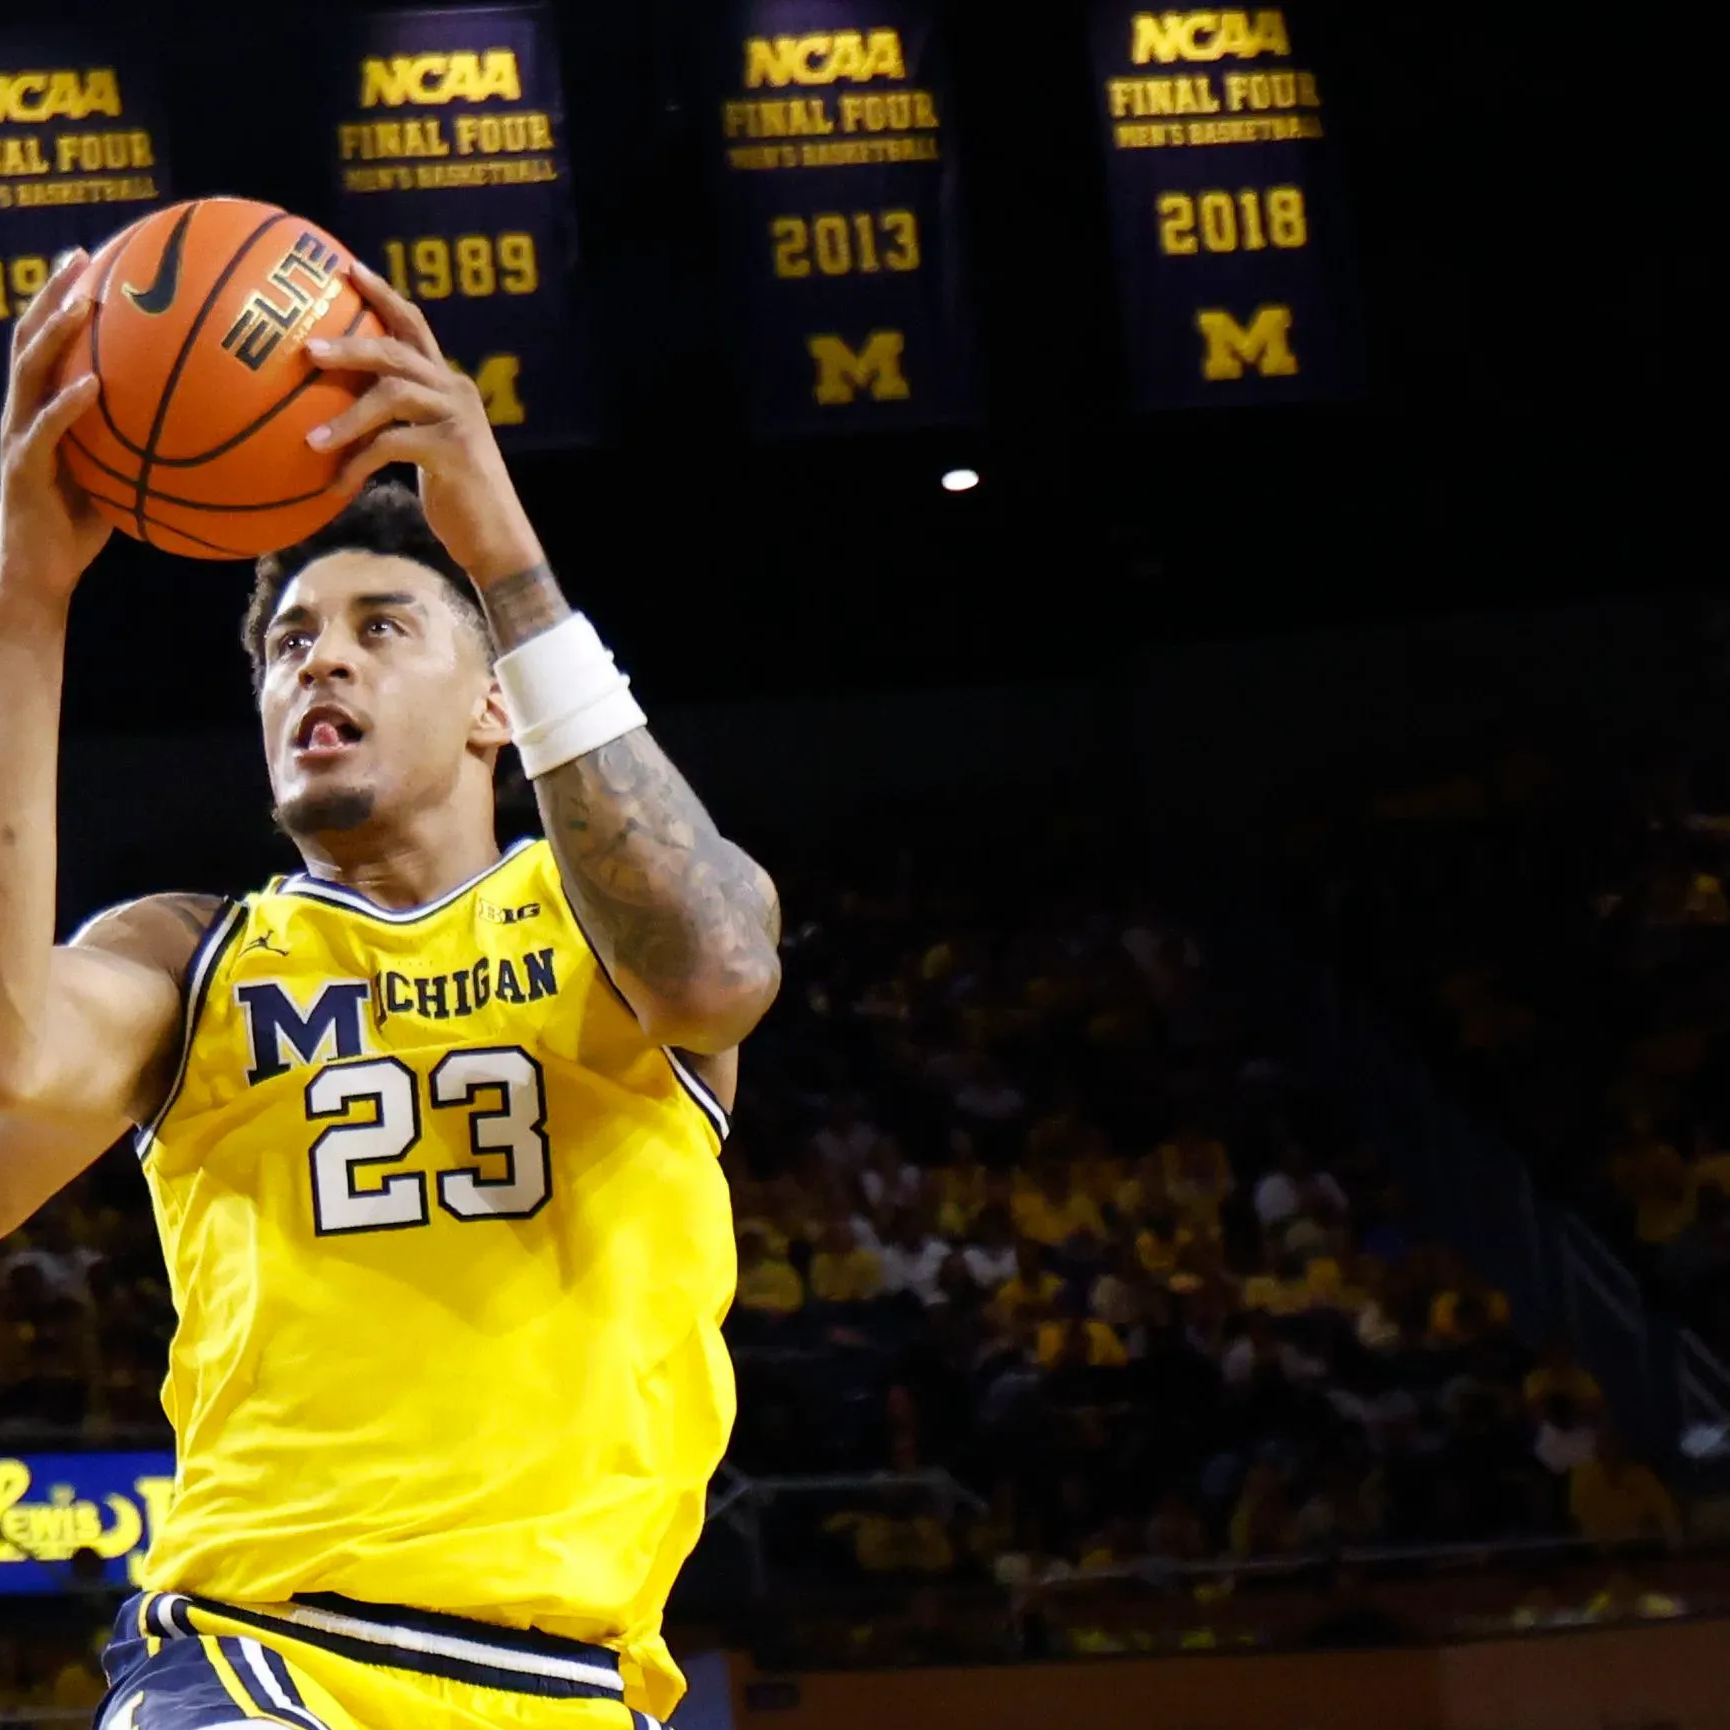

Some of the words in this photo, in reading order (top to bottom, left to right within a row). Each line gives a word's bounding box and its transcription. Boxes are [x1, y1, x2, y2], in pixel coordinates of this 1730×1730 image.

[744, 25, 907, 89] NCAA
[1130, 8, 1292, 66] NCAA
[360, 46, 522, 109] NCAA
[1105, 73, 1221, 120] FINAL
[1225, 68, 1322, 114] FOUR
[337, 116, 450, 162] FINAL
[456, 110, 556, 157] FOUR
[721, 94, 834, 140] FINAL
[841, 88, 941, 134] FOUR
[1112, 121, 1186, 151] MEN'S
[56, 129, 155, 175] FOUR
[769, 208, 922, 280] 2013
[1154, 183, 1309, 258] 2018
[383, 230, 539, 301] 1989
[804, 327, 911, 407] M
[1194, 301, 1300, 384] M
[233, 947, 559, 1088] MICHIGAN
[304, 1044, 554, 1238] 23
